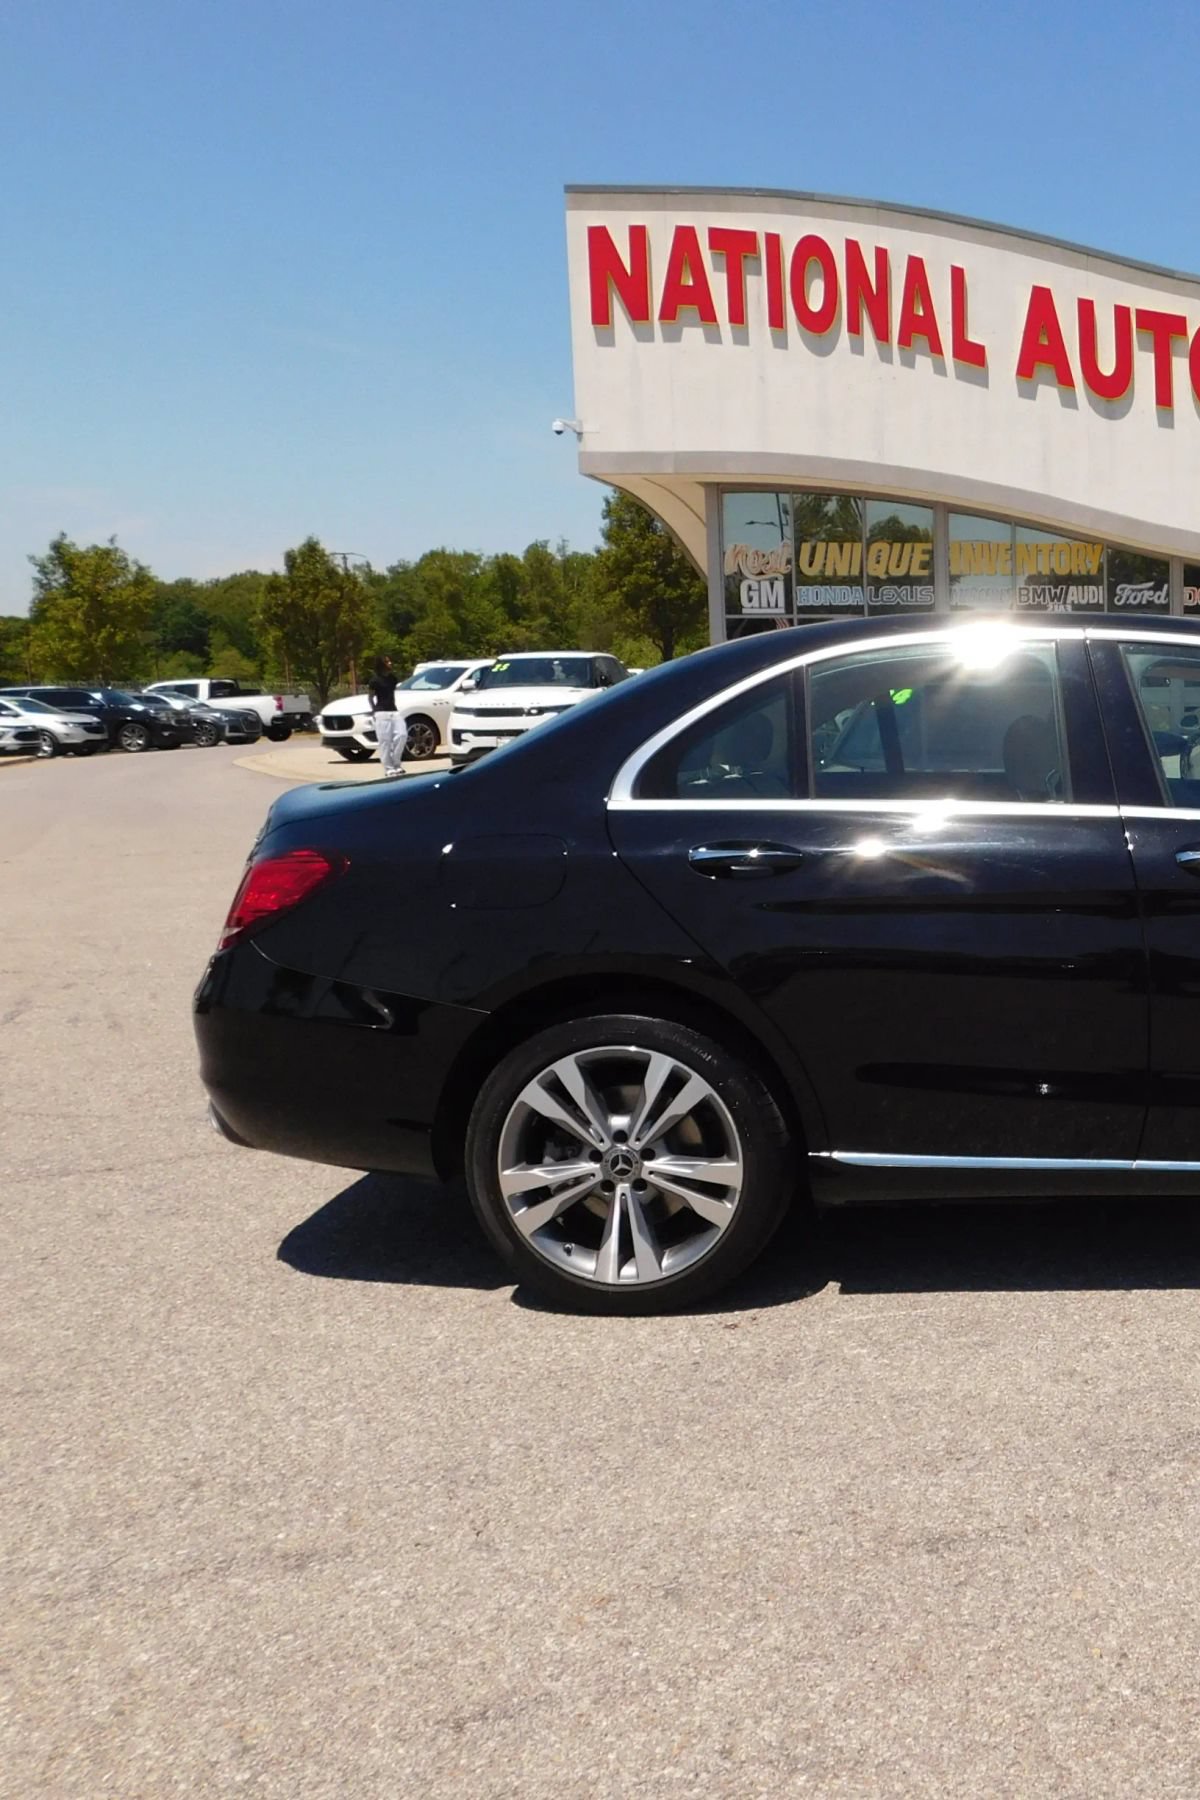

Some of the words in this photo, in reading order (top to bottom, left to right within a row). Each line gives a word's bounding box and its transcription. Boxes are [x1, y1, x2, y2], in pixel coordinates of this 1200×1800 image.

[587, 224, 986, 368] NATIONAL
[800, 541, 934, 578] UNIQUE
[949, 543, 1104, 577] INVENTORY
[740, 579, 785, 612] GM
[796, 585, 863, 605] HONDA
[866, 585, 934, 605] LEXUS
[1016, 585, 1104, 606] BMW/AUDI
[1114, 582, 1168, 606] Ford
